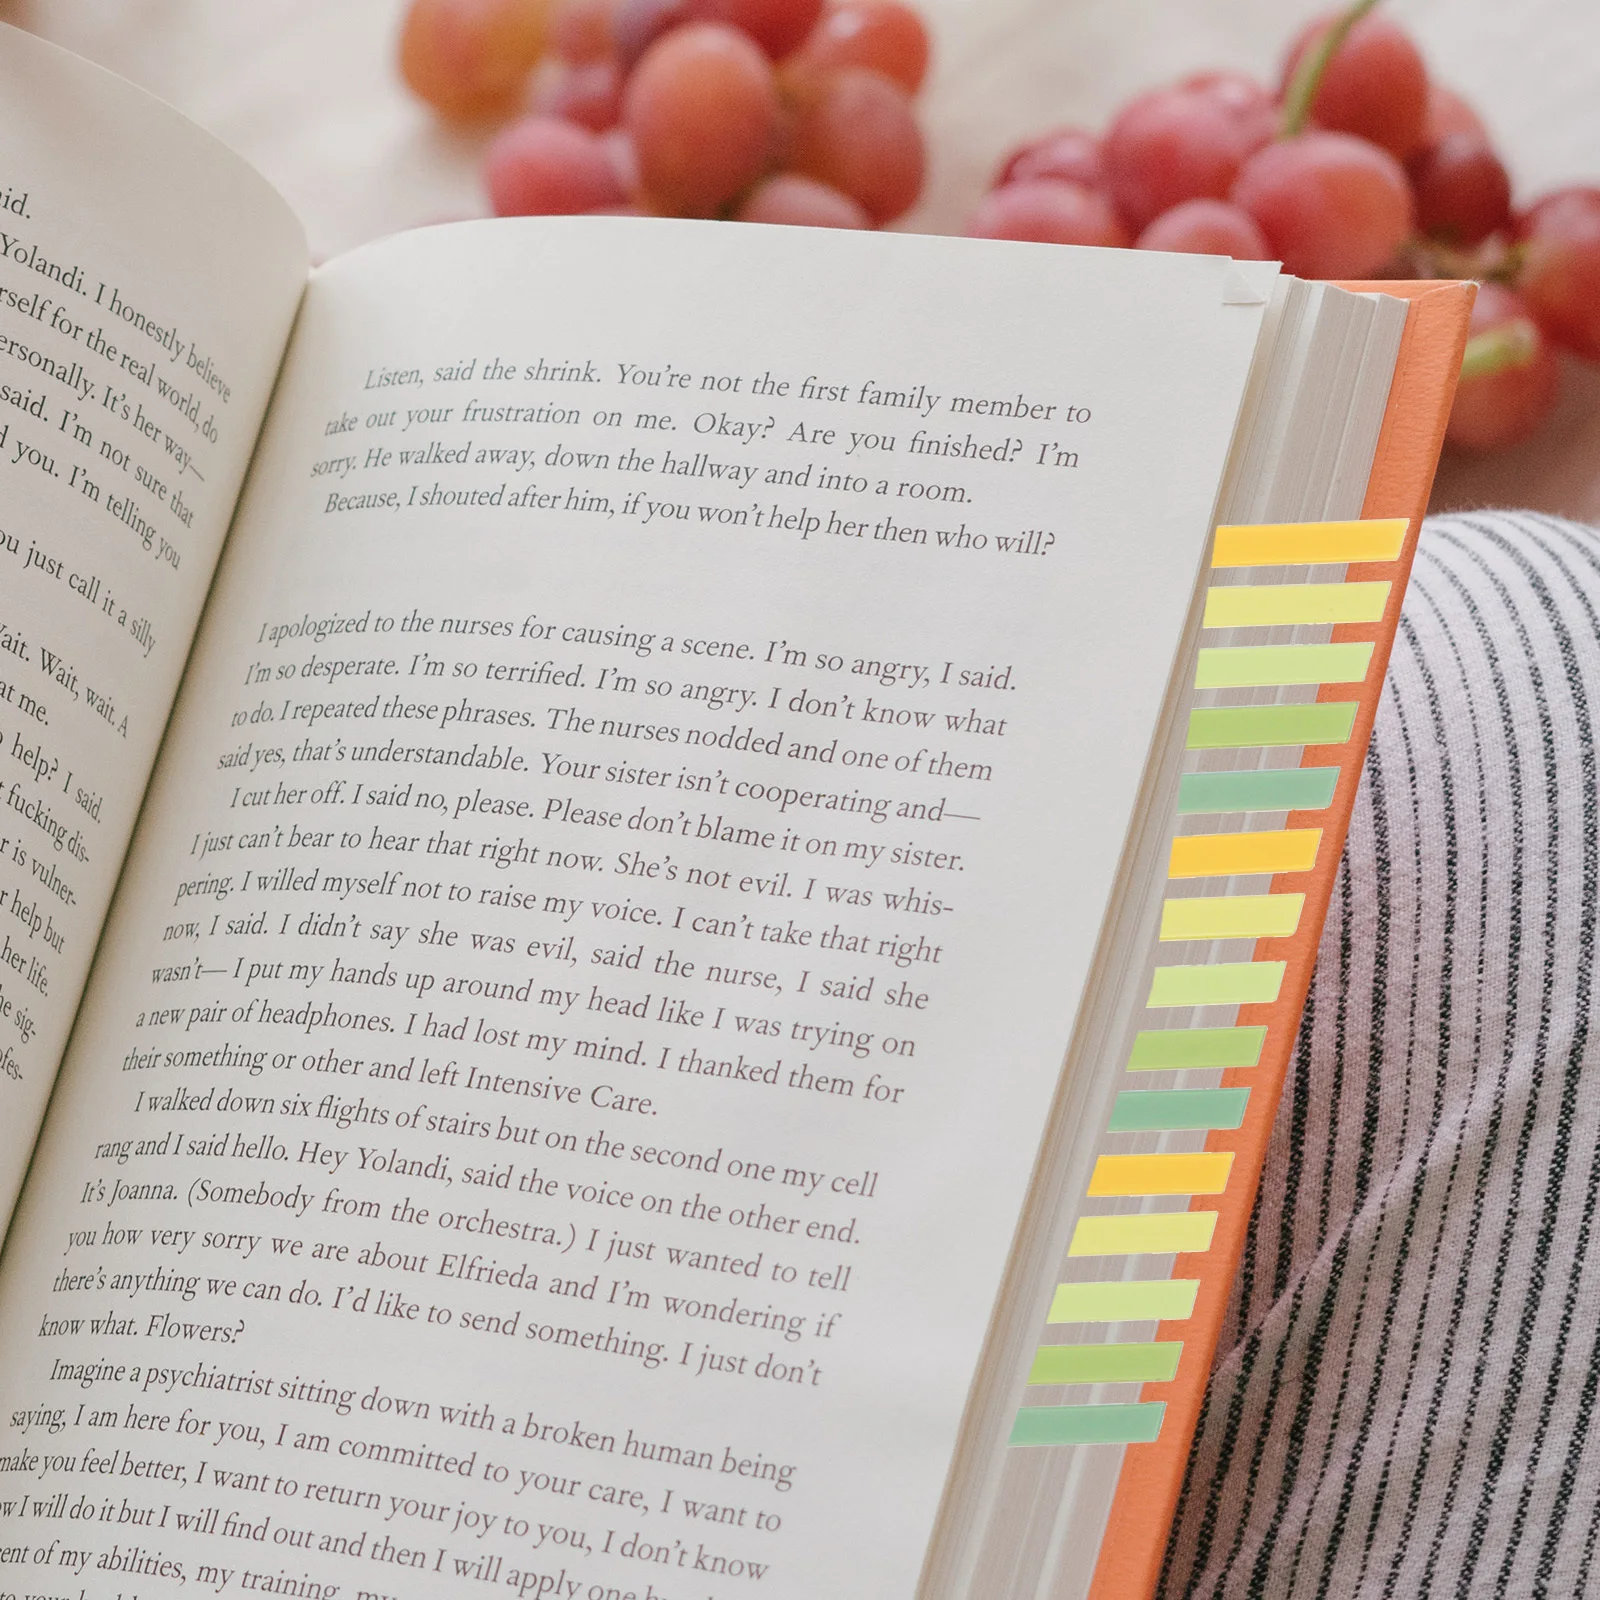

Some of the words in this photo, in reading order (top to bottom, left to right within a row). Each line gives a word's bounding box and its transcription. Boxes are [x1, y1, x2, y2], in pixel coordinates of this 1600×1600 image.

[0, 231, 88, 297] Yolandi.
[93, 281, 107, 306] I
[107, 287, 186, 363] honestly
[185, 342, 231, 404] believe
[49, 305, 85, 342] for
[85, 327, 118, 362] the
[119, 353, 157, 387] real
[157, 376, 202, 431] world,
[201, 414, 218, 444] do
[101, 384, 132, 421] It’s
[132, 403, 163, 444] her
[364, 367, 424, 390] Listen,
[432, 357, 478, 383] said
[482, 356, 517, 381] the
[523, 357, 602, 383] shrink.
[617, 363, 692, 389] You’re
[698, 375, 744, 394] not
[751, 370, 791, 398] the
[797, 375, 851, 403] first
[856, 379, 943, 419] family
[948, 393, 1058, 421] member
[1065, 404, 1092, 424] to
[0, 384, 49, 423] said.
[58, 409, 93, 448] I’m
[98, 440, 132, 473] not
[134, 465, 168, 502] sure
[169, 490, 194, 529] that
[310, 455, 357, 480] sorry.
[363, 447, 393, 469] He
[398, 440, 473, 466] walked
[474, 448, 536, 473] away,
[544, 442, 610, 470] down
[616, 447, 656, 473] the
[659, 449, 760, 490] hallway
[763, 462, 814, 488] and
[816, 465, 869, 494] into
[874, 479, 889, 496] a
[895, 481, 973, 504] room.
[10, 439, 60, 479] you.
[67, 464, 101, 504] I’m
[105, 493, 157, 552] telling
[154, 536, 181, 571] you
[22, 539, 65, 581] just
[68, 572, 102, 605] call
[101, 589, 116, 617] it
[117, 609, 128, 628] a
[129, 617, 157, 659] silly
[257, 622, 269, 644] I
[268, 609, 372, 649] apologized
[373, 615, 396, 633] to
[400, 608, 435, 633] the
[438, 618, 515, 637] nurses
[518, 613, 558, 641] for
[561, 623, 657, 659] causing
[660, 636, 675, 653] a
[680, 638, 755, 661] scene.
[763, 639, 808, 668] I’m
[814, 653, 845, 672] so
[850, 658, 931, 690] angry,
[939, 661, 955, 685] I
[957, 664, 1016, 691] said.
[16, 693, 49, 727] me.
[39, 646, 80, 702] Wait,
[85, 686, 116, 727] wait.
[116, 714, 129, 739] A
[11, 732, 59, 783] help?
[62, 770, 74, 795] I
[74, 787, 104, 825] said.
[216, 741, 254, 770] said
[249, 747, 286, 773] yes,
[292, 737, 348, 763] that’s
[350, 737, 529, 773] understandable.
[541, 751, 602, 780] Your
[604, 759, 673, 788] sister
[674, 765, 731, 795] isn’t
[734, 781, 893, 825] cooperating
[6, 783, 68, 852] fucking
[67, 829, 90, 863] dis-
[11, 838, 28, 867] is
[31, 858, 77, 907] vulner-
[10, 889, 43, 939] help
[43, 916, 66, 954] but
[173, 871, 235, 907] pering.
[239, 869, 254, 892] I
[256, 866, 321, 892] willed
[320, 870, 404, 902] myself
[400, 881, 444, 900] not
[447, 882, 472, 903] to
[477, 883, 537, 911] raise
[541, 895, 585, 924] my
[590, 897, 663, 927] voice.
[671, 905, 687, 930] I
[691, 913, 755, 940] can’t
[760, 919, 813, 947] take
[819, 923, 872, 954] that
[875, 933, 944, 969] right
[0, 934, 28, 975] her
[25, 955, 49, 998] life.
[13, 1006, 37, 1045] sig-
[121, 1045, 163, 1072] their
[163, 1041, 269, 1077] something
[271, 1052, 298, 1070] or
[301, 1047, 365, 1076] other
[367, 1056, 416, 1082] and
[417, 1057, 461, 1087] left
[463, 1065, 582, 1104] Intensive
[590, 1084, 658, 1116] Care.
[79, 1177, 107, 1204] It’s
[106, 1178, 178, 1208] Joanna.
[187, 1176, 316, 1219] (Somebody
[320, 1186, 381, 1220] from
[390, 1196, 430, 1226] the
[437, 1207, 577, 1255] orchestra.)
[585, 1227, 601, 1252] I
[603, 1230, 657, 1263] just
[666, 1246, 764, 1278] wanted
[770, 1262, 798, 1284] to
[807, 1264, 852, 1293] tell
[37, 1312, 87, 1338] know
[89, 1309, 138, 1337] what.
[144, 1311, 246, 1345] Flowers?
[48, 1356, 127, 1390] Imagine
[128, 1365, 142, 1383] a
[140, 1361, 275, 1397] psychiatrist
[277, 1375, 358, 1417] sitting
[360, 1385, 431, 1420] down
[439, 1401, 496, 1432] with
[501, 1417, 517, 1436] a
[520, 1411, 616, 1454] broken
[621, 1428, 714, 1471] human
[719, 1445, 798, 1493] being
[0, 1446, 40, 1473] make
[37, 1454, 77, 1481] you
[78, 1446, 121, 1475] feel
[118, 1449, 188, 1489] better,
[193, 1460, 209, 1485] I
[212, 1468, 271, 1493] want
[274, 1475, 299, 1497] to
[302, 1482, 382, 1511] return
[383, 1495, 452, 1523] your
[450, 1500, 499, 1540] joy
[503, 1515, 530, 1537] to
[531, 1523, 593, 1557] you,
[600, 1529, 616, 1554] I
[619, 1531, 689, 1568] don’t
[691, 1543, 770, 1581] know
[32, 1538, 61, 1565] of
[57, 1549, 94, 1577] my
[96, 1544, 187, 1587] abilities,
[194, 1565, 236, 1595] my
